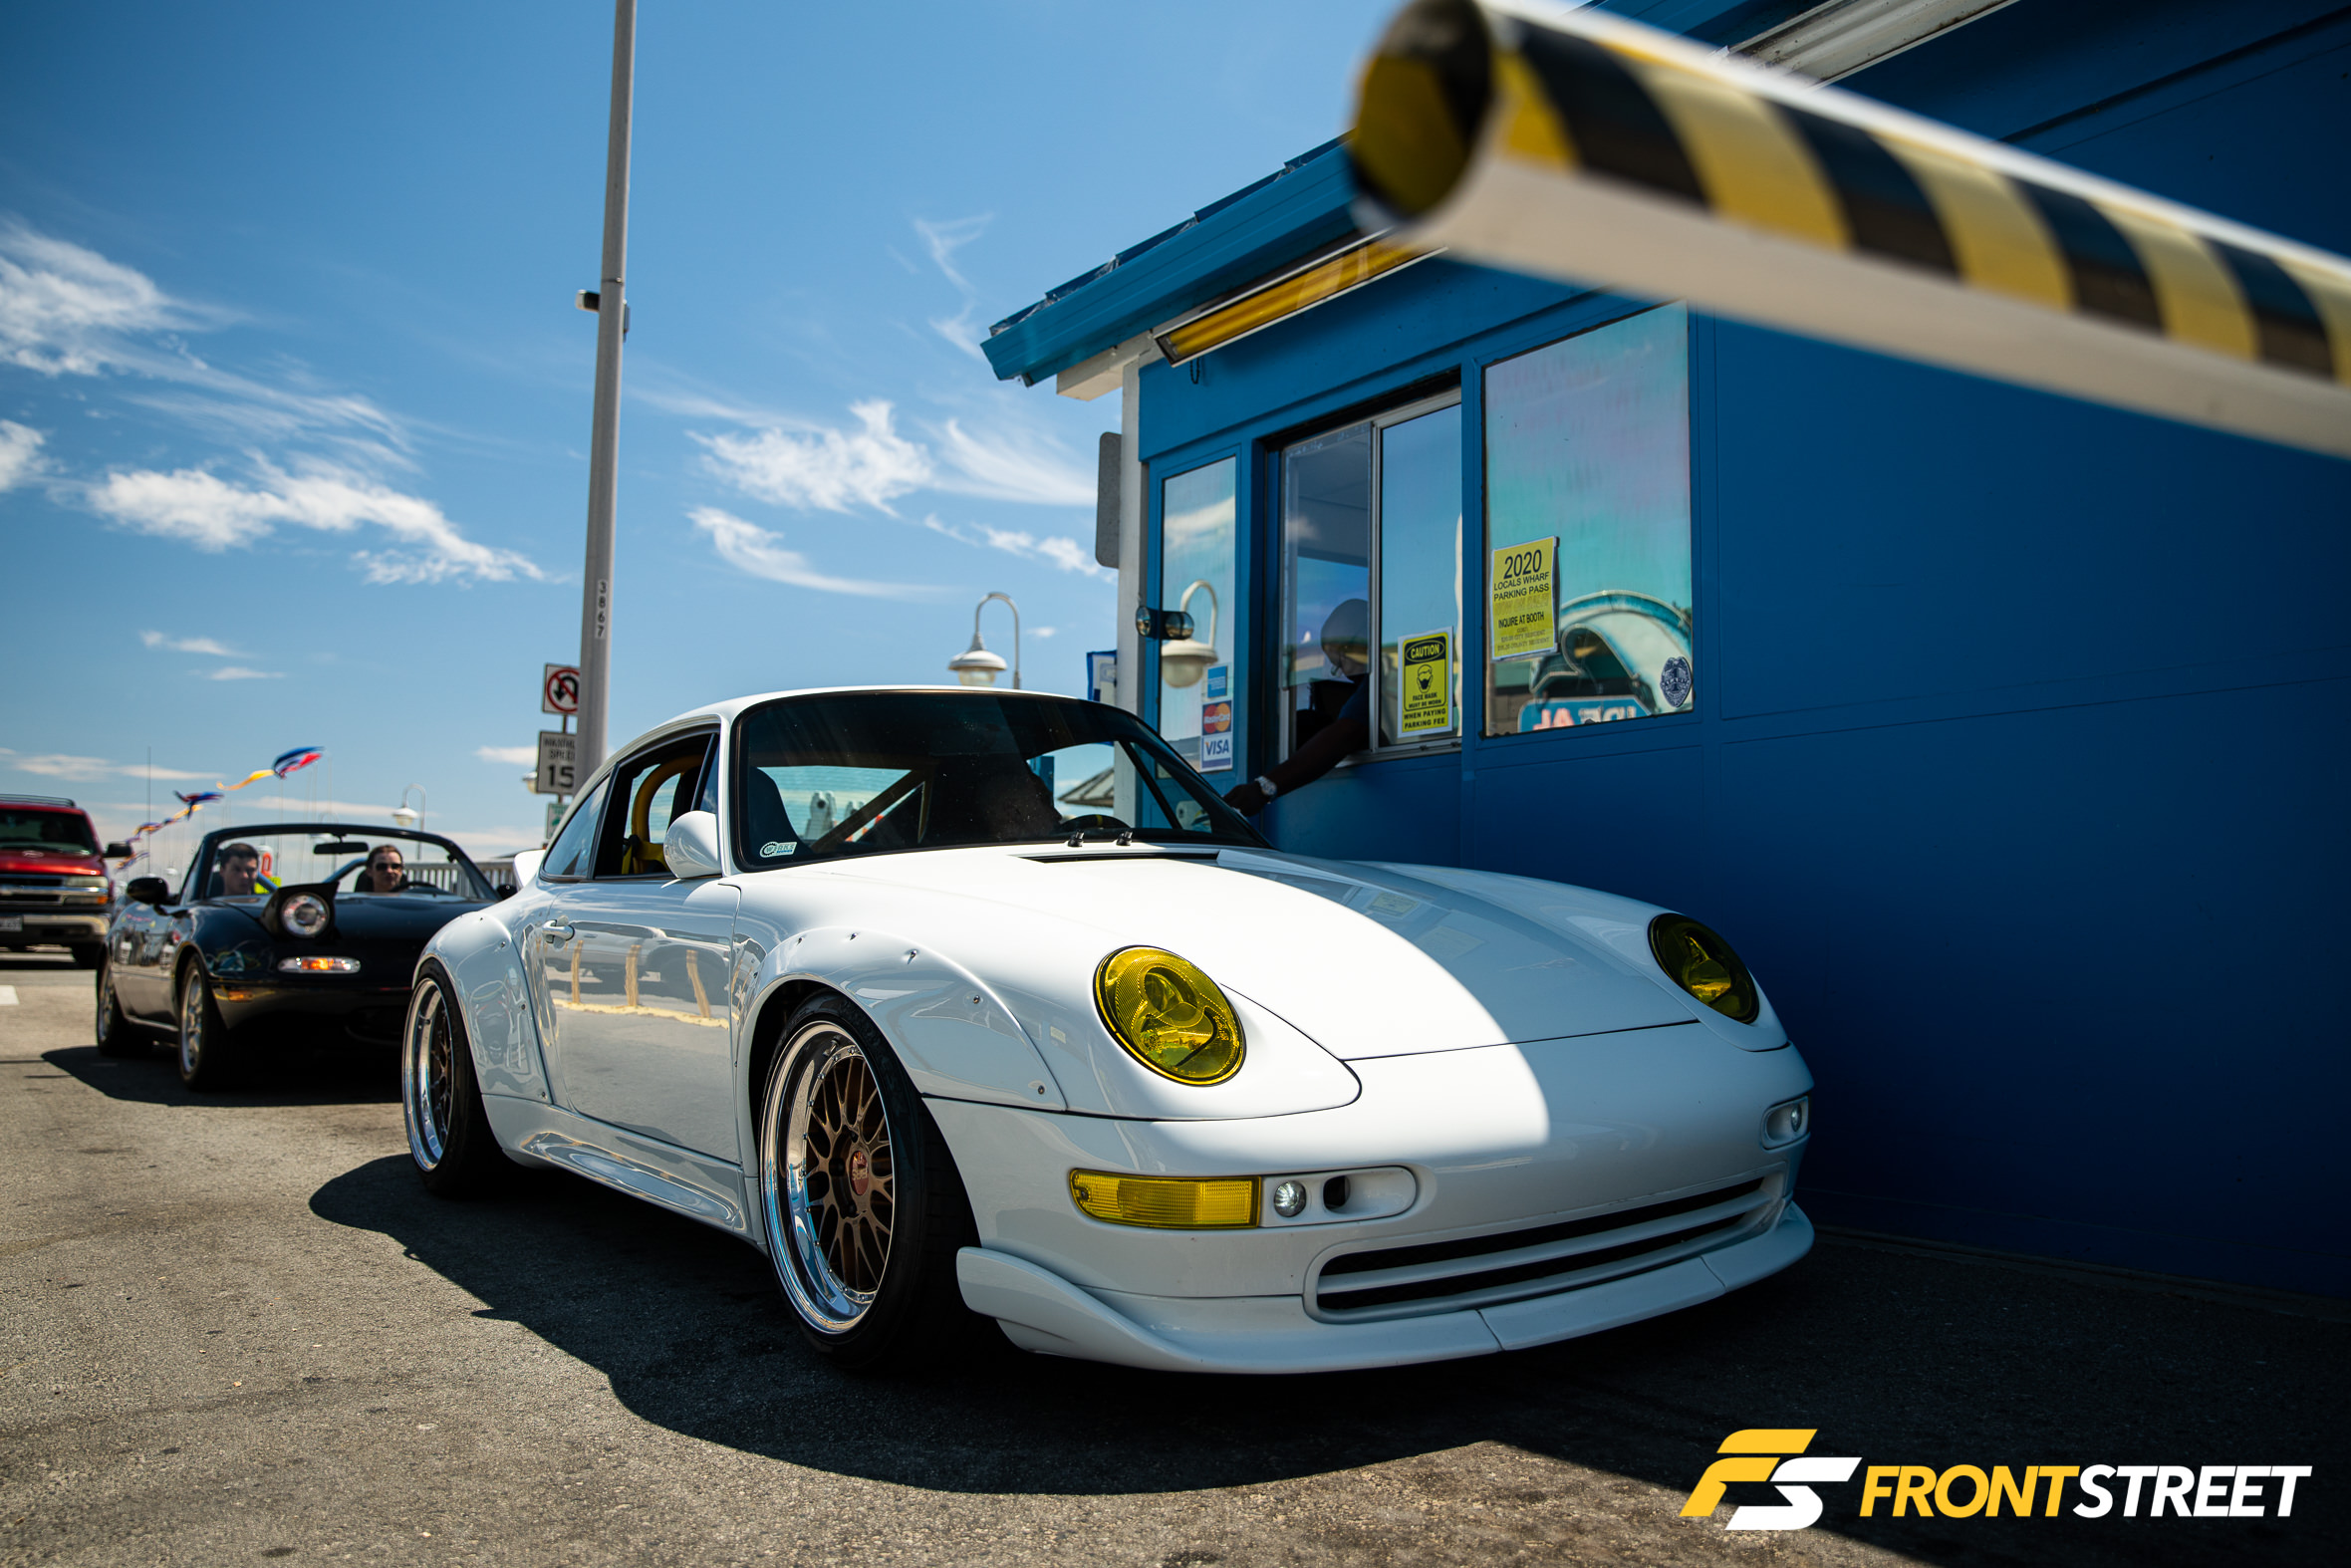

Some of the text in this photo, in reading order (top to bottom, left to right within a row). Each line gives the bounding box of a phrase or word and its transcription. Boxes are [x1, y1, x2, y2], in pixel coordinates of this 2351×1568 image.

[1503, 549, 1542, 579] 2020
[1494, 572, 1549, 591] LOCALS WHARF
[1494, 583, 1549, 602] PARKING PASS
[598, 581, 607, 638] 3867
[1498, 611, 1544, 629] INQUIRE AT BOOTH
[1411, 644, 1439, 658] CAUTION
[1404, 708, 1445, 720] WHEN PAYING
[1405, 719, 1432, 729] PARKING
[1204, 739, 1229, 756] VISA
[548, 765, 575, 788] 15
